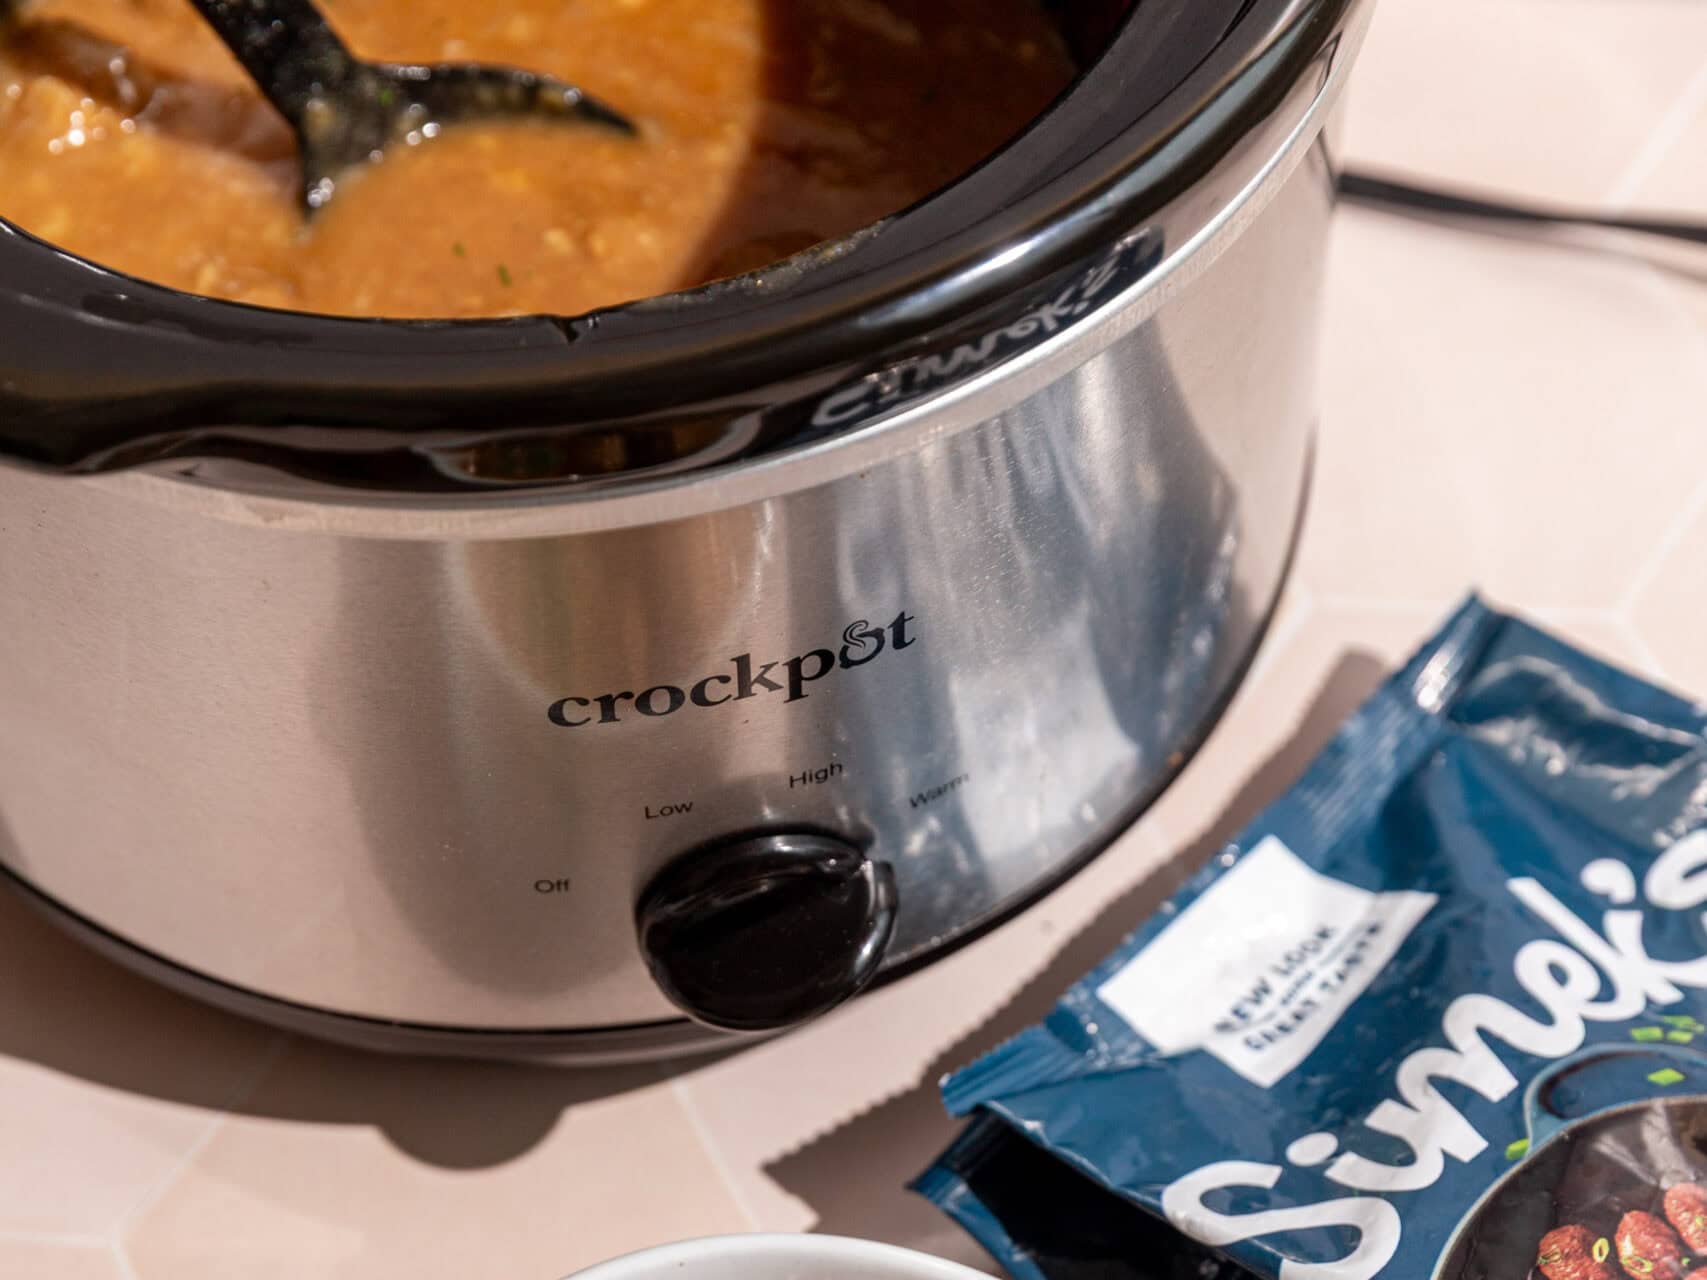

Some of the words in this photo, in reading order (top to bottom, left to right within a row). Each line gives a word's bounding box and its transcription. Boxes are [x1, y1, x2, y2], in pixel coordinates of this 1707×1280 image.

[547, 610, 917, 727] crockpot
[788, 761, 844, 789] High
[909, 773, 970, 809] Warm
[644, 800, 694, 820] Low
[534, 878, 570, 894] Off
[1213, 976, 1272, 1034] NEW
[1269, 925, 1334, 978] LOOK
